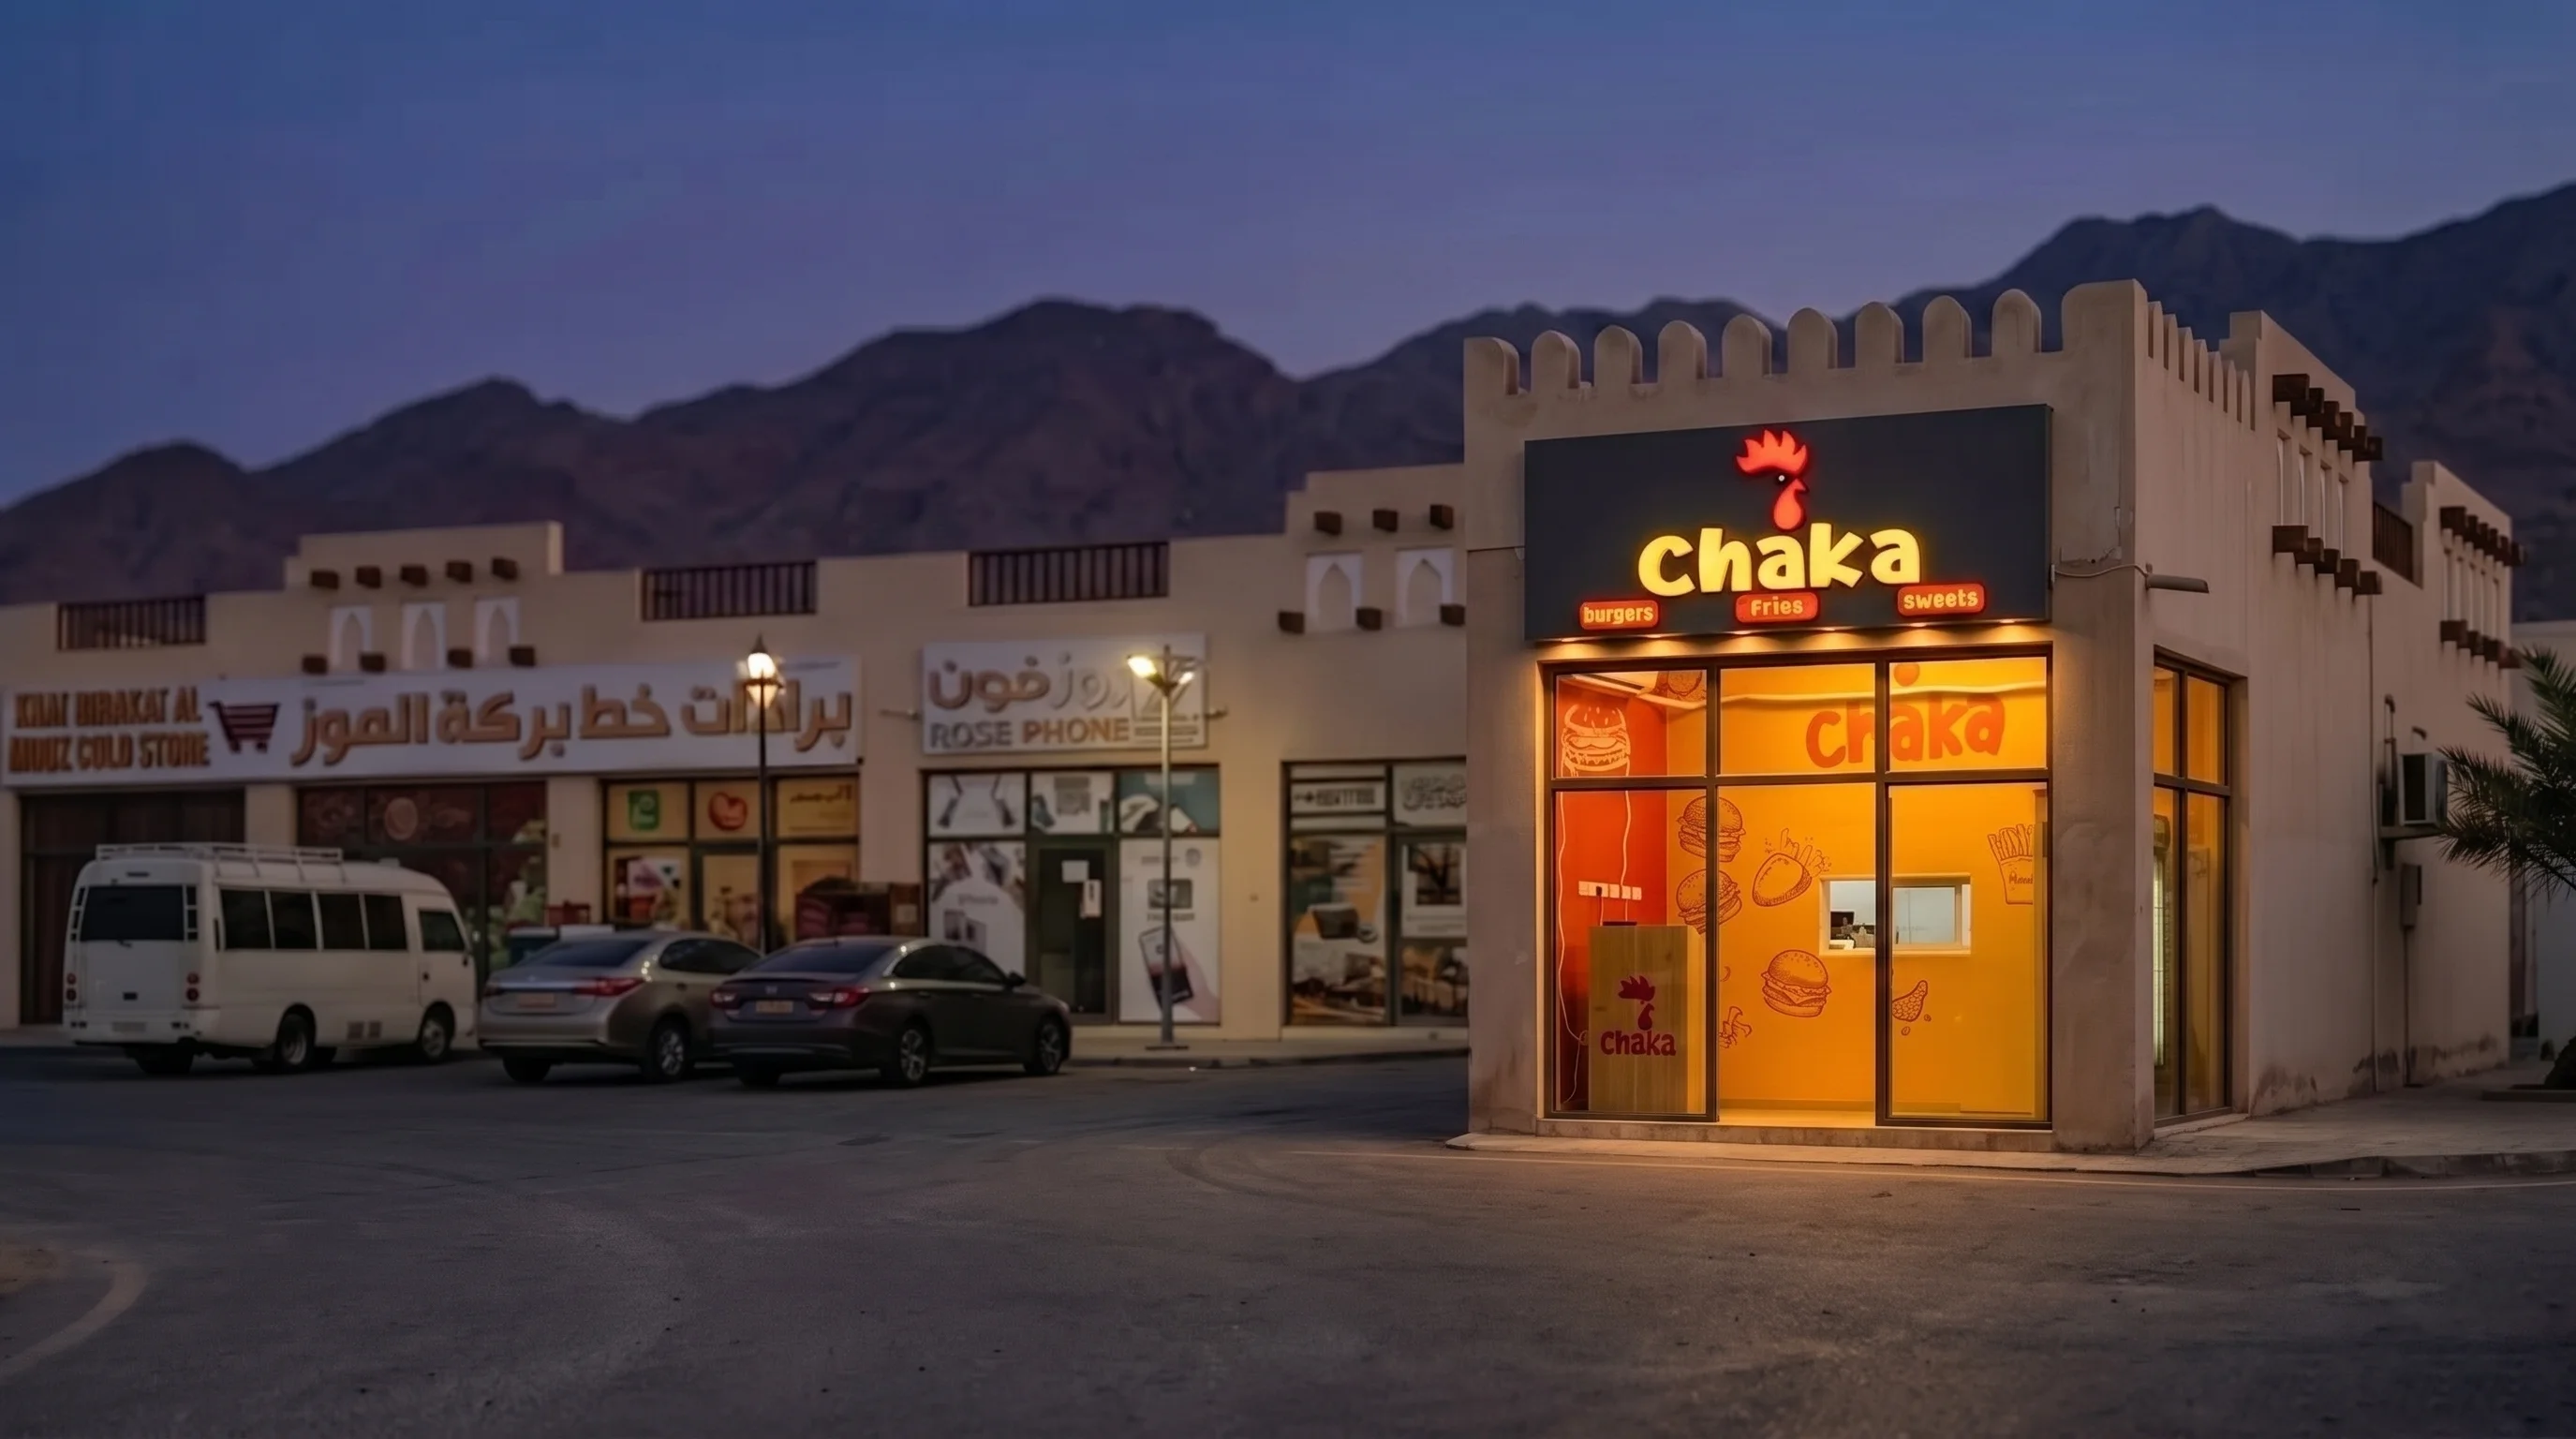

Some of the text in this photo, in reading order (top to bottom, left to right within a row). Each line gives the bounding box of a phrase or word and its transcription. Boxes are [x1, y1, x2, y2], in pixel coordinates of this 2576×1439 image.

[1637, 522, 1921, 598] chaka
[1582, 603, 1654, 626] burgers
[1902, 587, 1979, 610] sweets
[173, 686, 202, 724] AL
[928, 656, 1050, 714] فون
[291, 691, 430, 767] الموز
[437, 690, 570, 761] بركة
[579, 683, 671, 741] خط
[929, 720, 1013, 749] ROSE
[1022, 717, 1130, 745] PHONE
[138, 732, 211, 768] STORE
